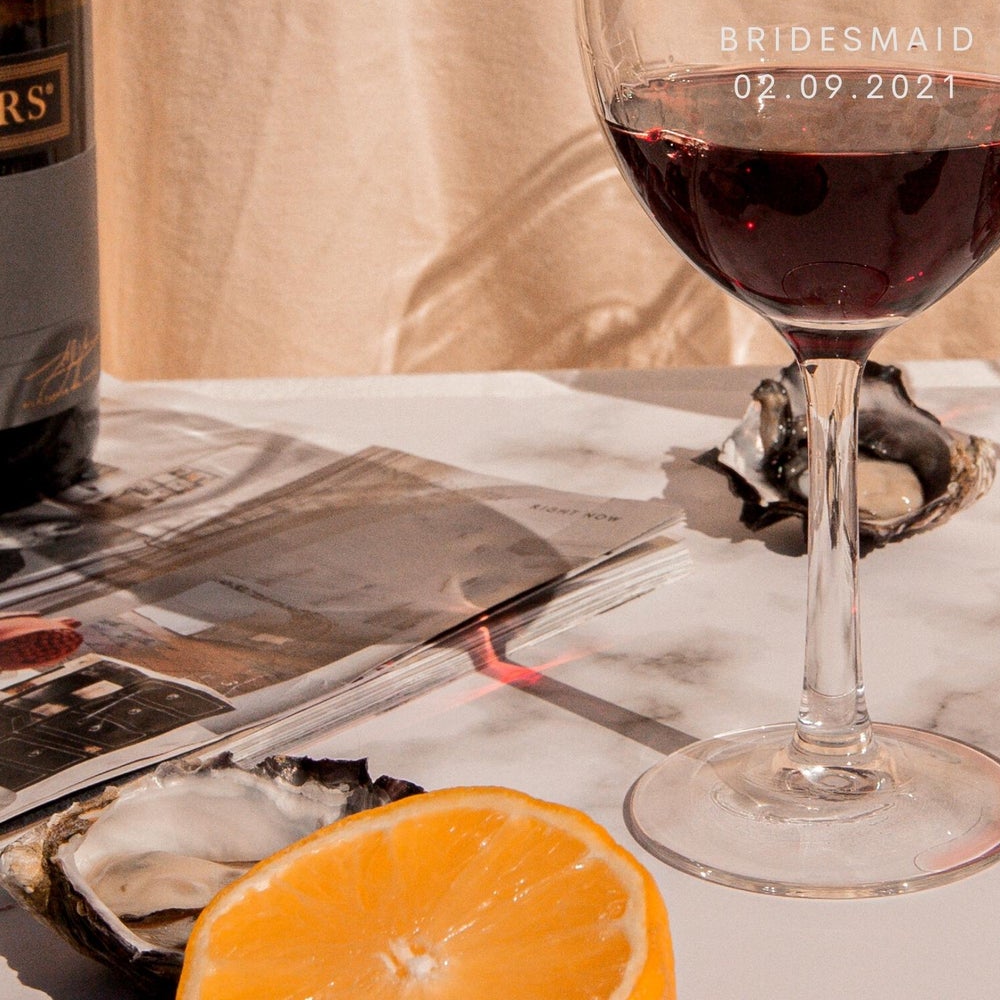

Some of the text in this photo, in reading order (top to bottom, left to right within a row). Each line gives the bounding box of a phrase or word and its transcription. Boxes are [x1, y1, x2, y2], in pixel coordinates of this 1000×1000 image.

[720, 26, 974, 52] BRIDESMAID
[733, 74, 955, 100] 02.09.2021
[530, 503, 620, 523] RIGHT NOW
